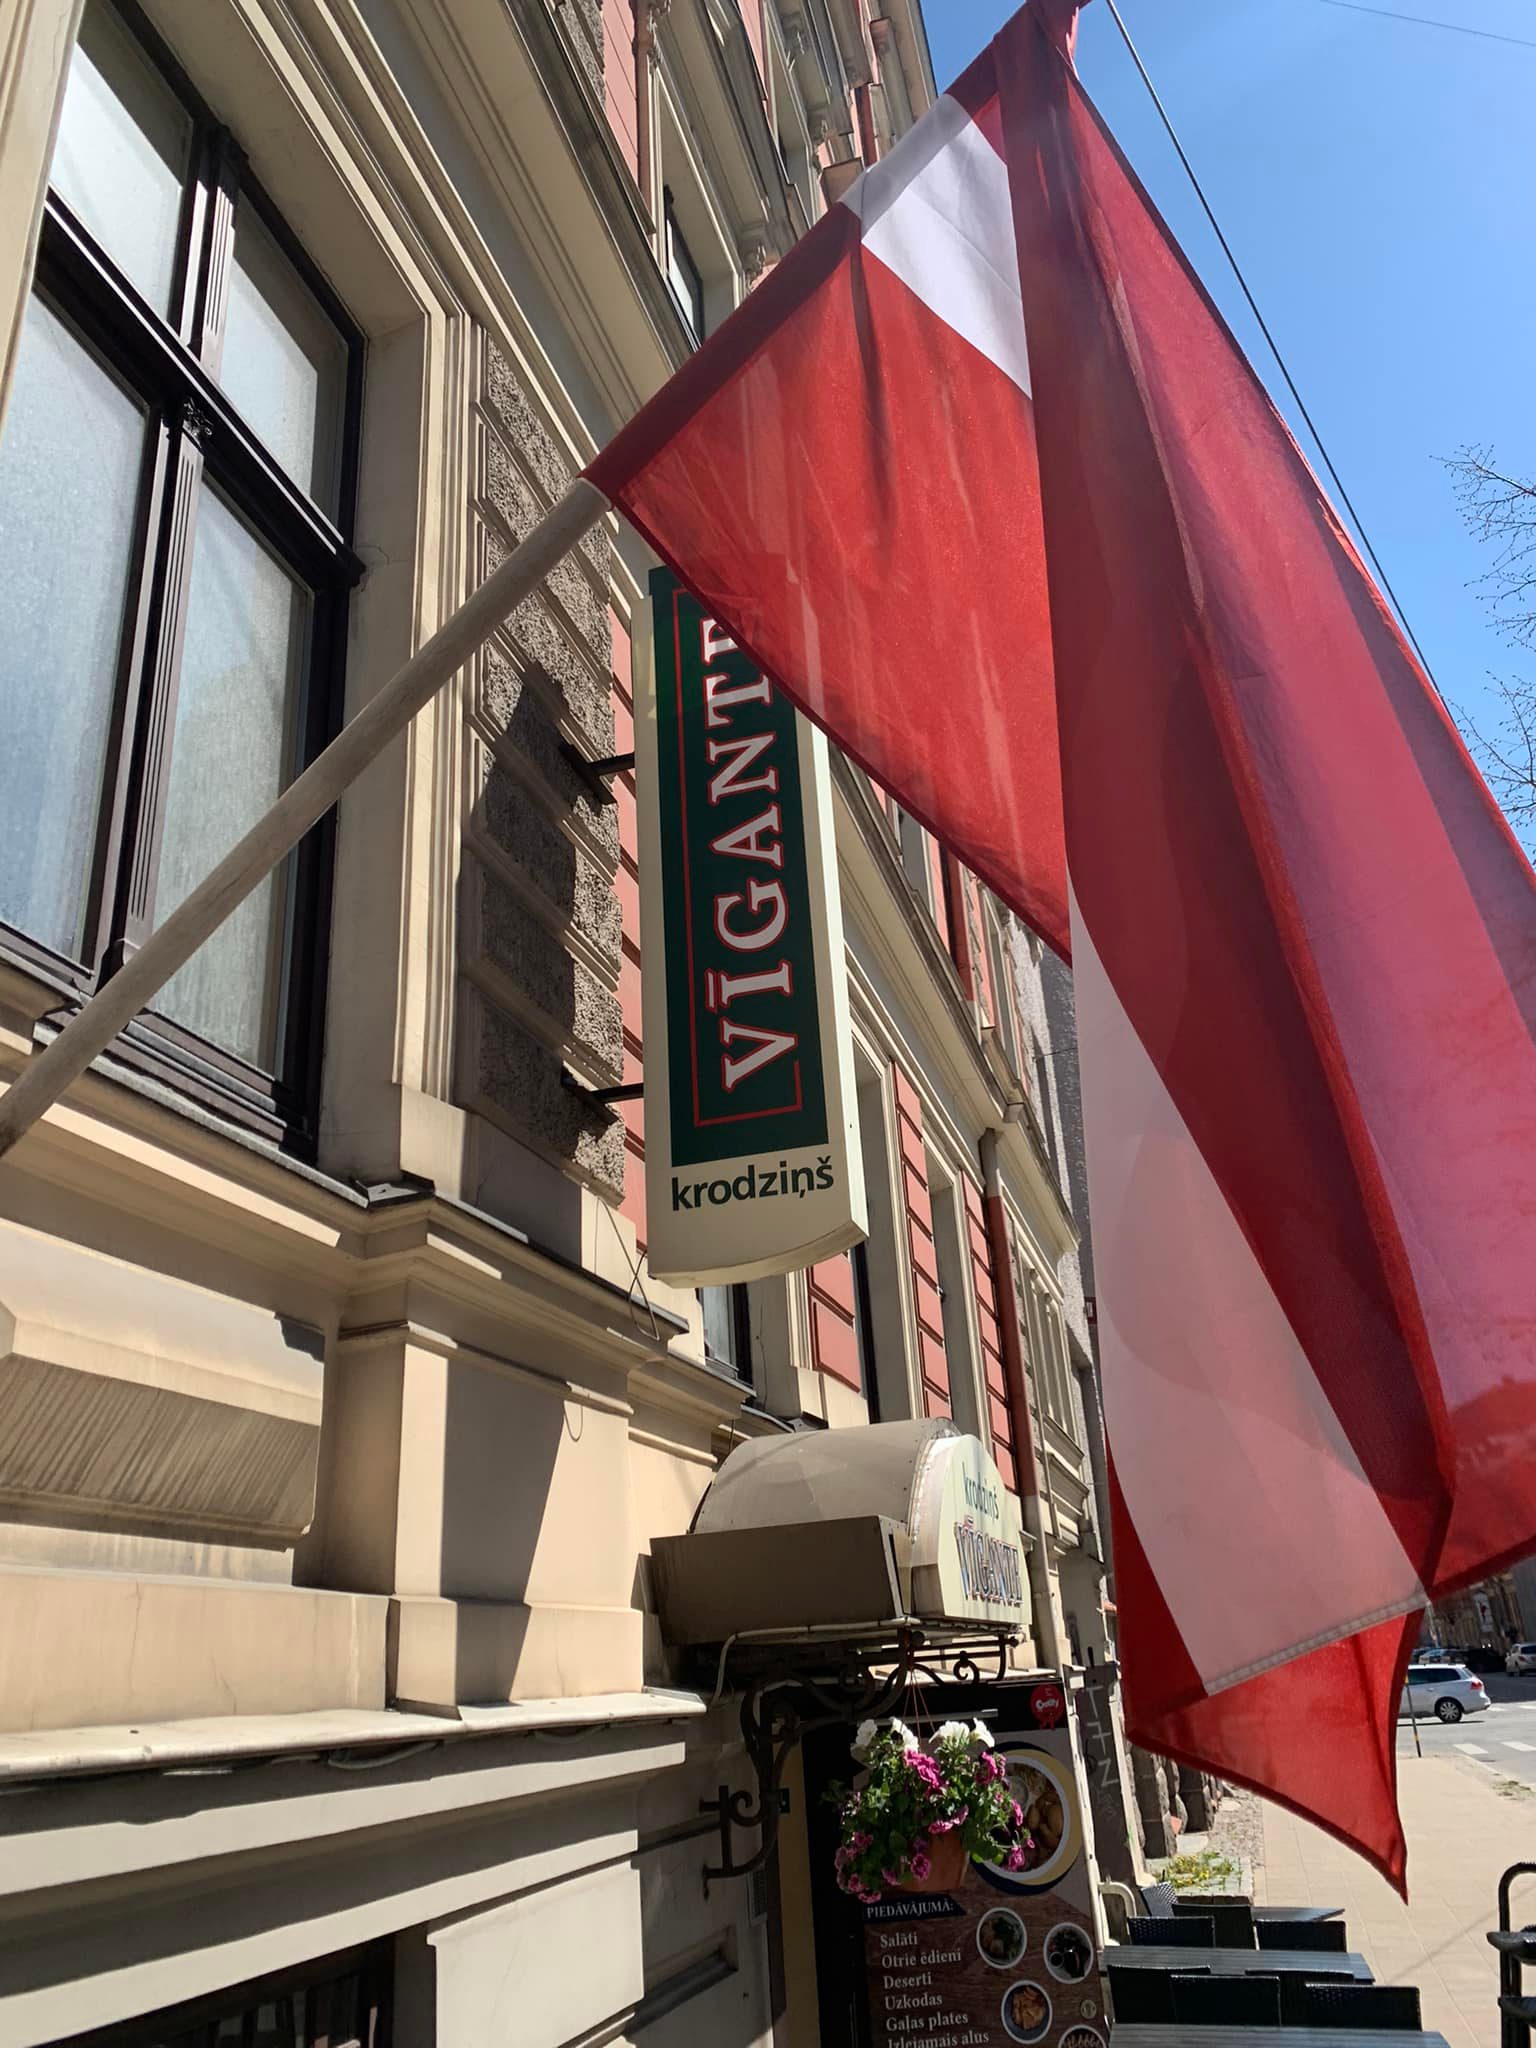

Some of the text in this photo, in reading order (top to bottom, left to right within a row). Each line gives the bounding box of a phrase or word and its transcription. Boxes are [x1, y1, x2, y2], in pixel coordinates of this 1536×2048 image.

[671, 1156, 833, 1212] krodziņš
[866, 1898, 954, 1919] PIEDĀVĀJUMĀ:
[880, 1931, 918, 1949] Salāti
[881, 1948, 962, 1969] Otrie ēdieni
[883, 1971, 932, 1990] Deserti
[885, 1992, 943, 2011] Uzkodas
[886, 2011, 969, 2033] Gaļas plates
[961, 2030, 990, 2046] alus
